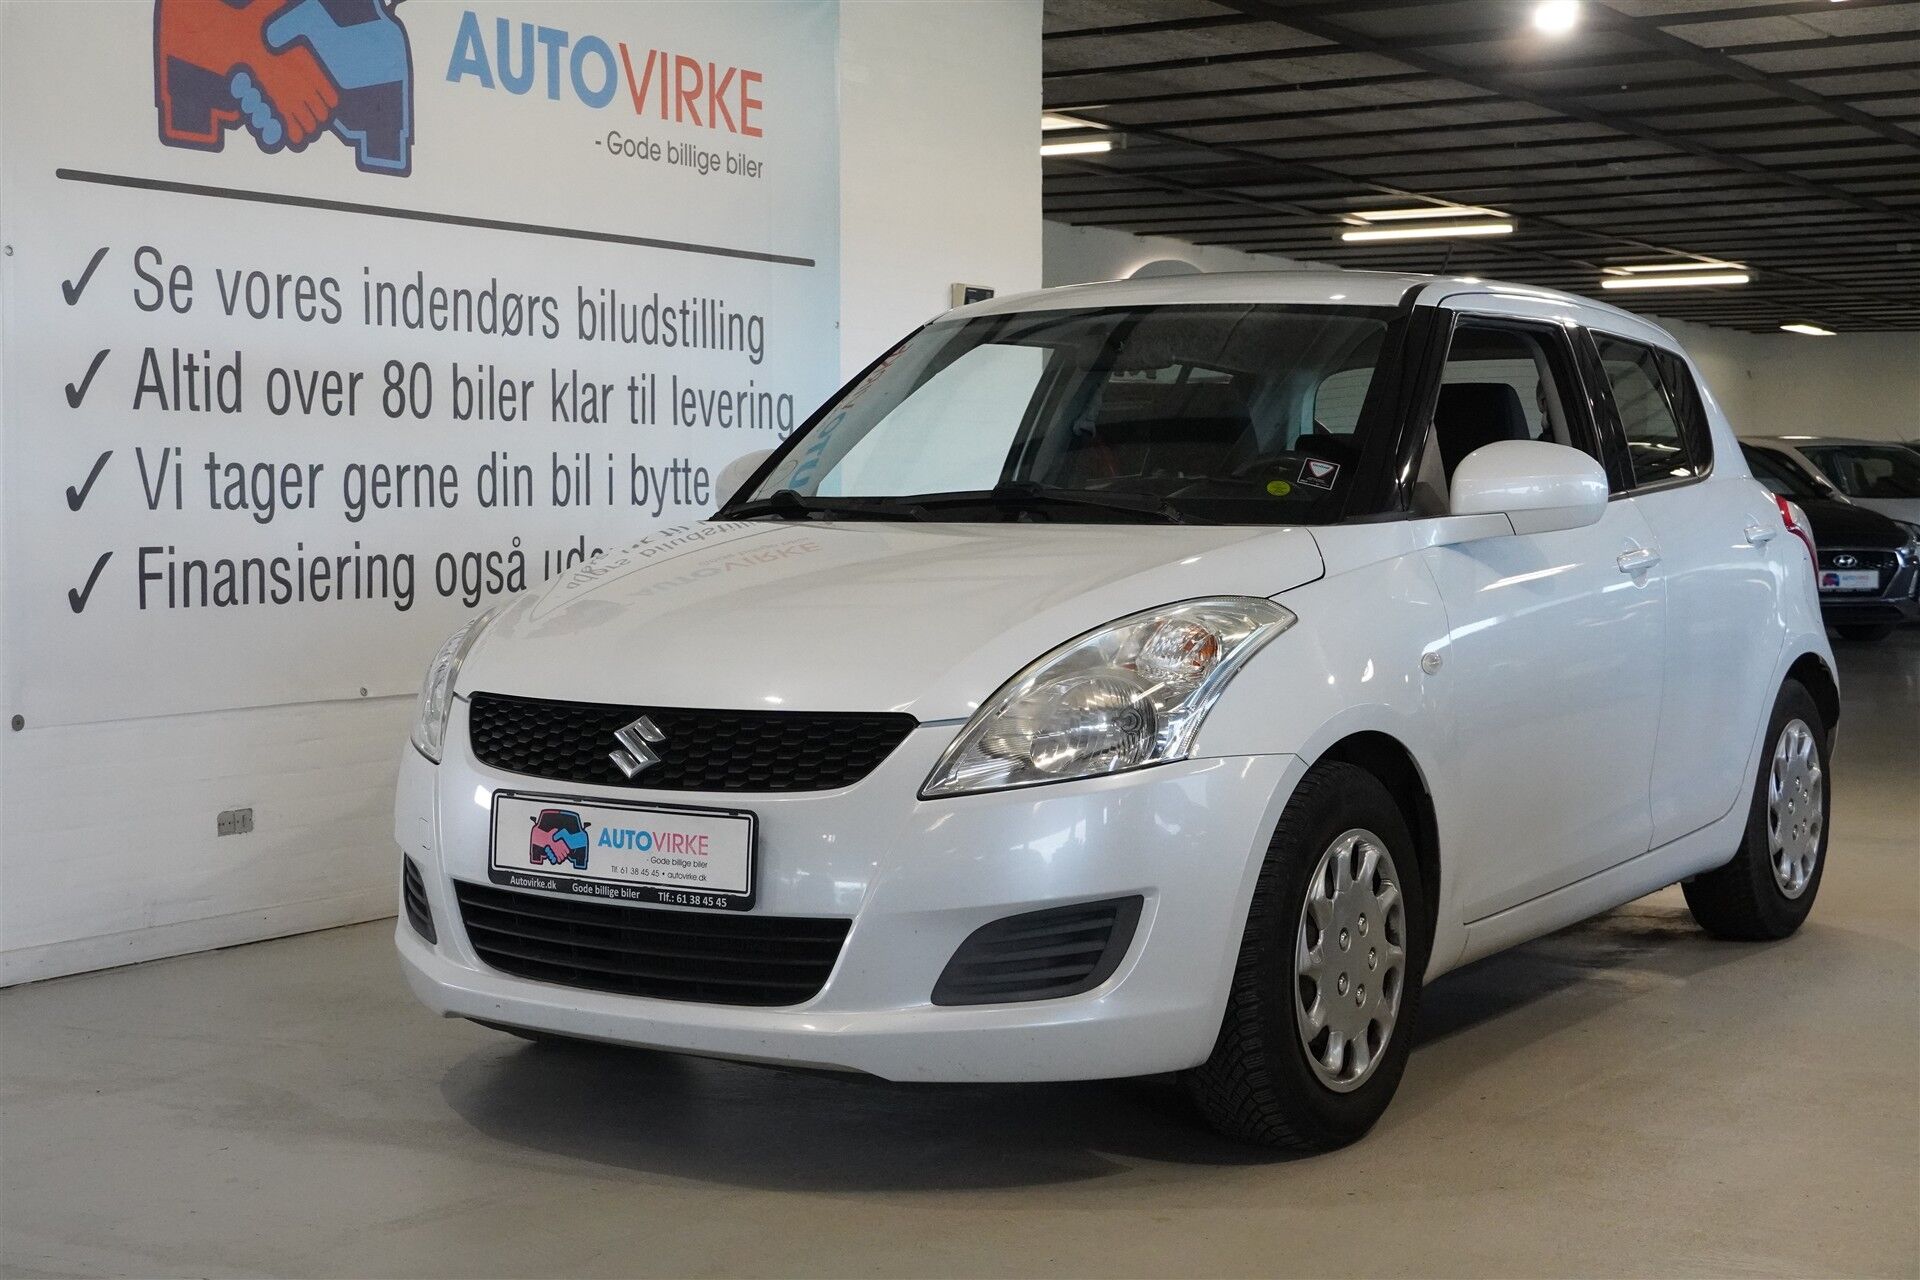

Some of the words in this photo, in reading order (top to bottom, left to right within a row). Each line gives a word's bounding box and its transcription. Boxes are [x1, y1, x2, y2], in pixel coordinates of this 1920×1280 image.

[445, 9, 763, 139] AUTOVIRKE
[606, 130, 662, 162] Gode
[667, 140, 721, 176] billige
[726, 150, 763, 179] biler
[133, 245, 193, 314] Se
[215, 268, 343, 325] vores
[363, 266, 560, 340] indendørs
[577, 285, 764, 365] biludstilling
[132, 347, 242, 414] Altid
[266, 367, 364, 417] over
[382, 359, 433, 420] 80
[452, 362, 535, 422] biler
[551, 368, 615, 424] klar
[627, 372, 656, 425] til
[672, 374, 795, 442] levering
[135, 446, 183, 511] Vi
[204, 451, 324, 525] tager
[343, 463, 459, 523] gerne
[477, 450, 533, 509] din
[552, 451, 591, 508] bil
[608, 453, 614, 506] i
[631, 452, 710, 518] bytte
[138, 540, 415, 612] Finansiering
[435, 536, 527, 607] også
[597, 827, 709, 856] AUTOVIRKE
[620, 866, 629, 875] 61
[630, 867, 639, 876] 38
[640, 868, 650, 877] 45
[651, 869, 660, 878] 45
[650, 856, 671, 866] Gode
[671, 858, 692, 869] billige
[693, 860, 708, 869] biler
[510, 875, 557, 890] Autovirke.dk
[572, 882, 594, 894] Gode
[594, 885, 620, 898] billige
[620, 887, 641, 899] biler
[676, 893, 688, 904] 61
[689, 894, 701, 906] 38
[702, 896, 714, 907] 45
[715, 897, 728, 908] 45
